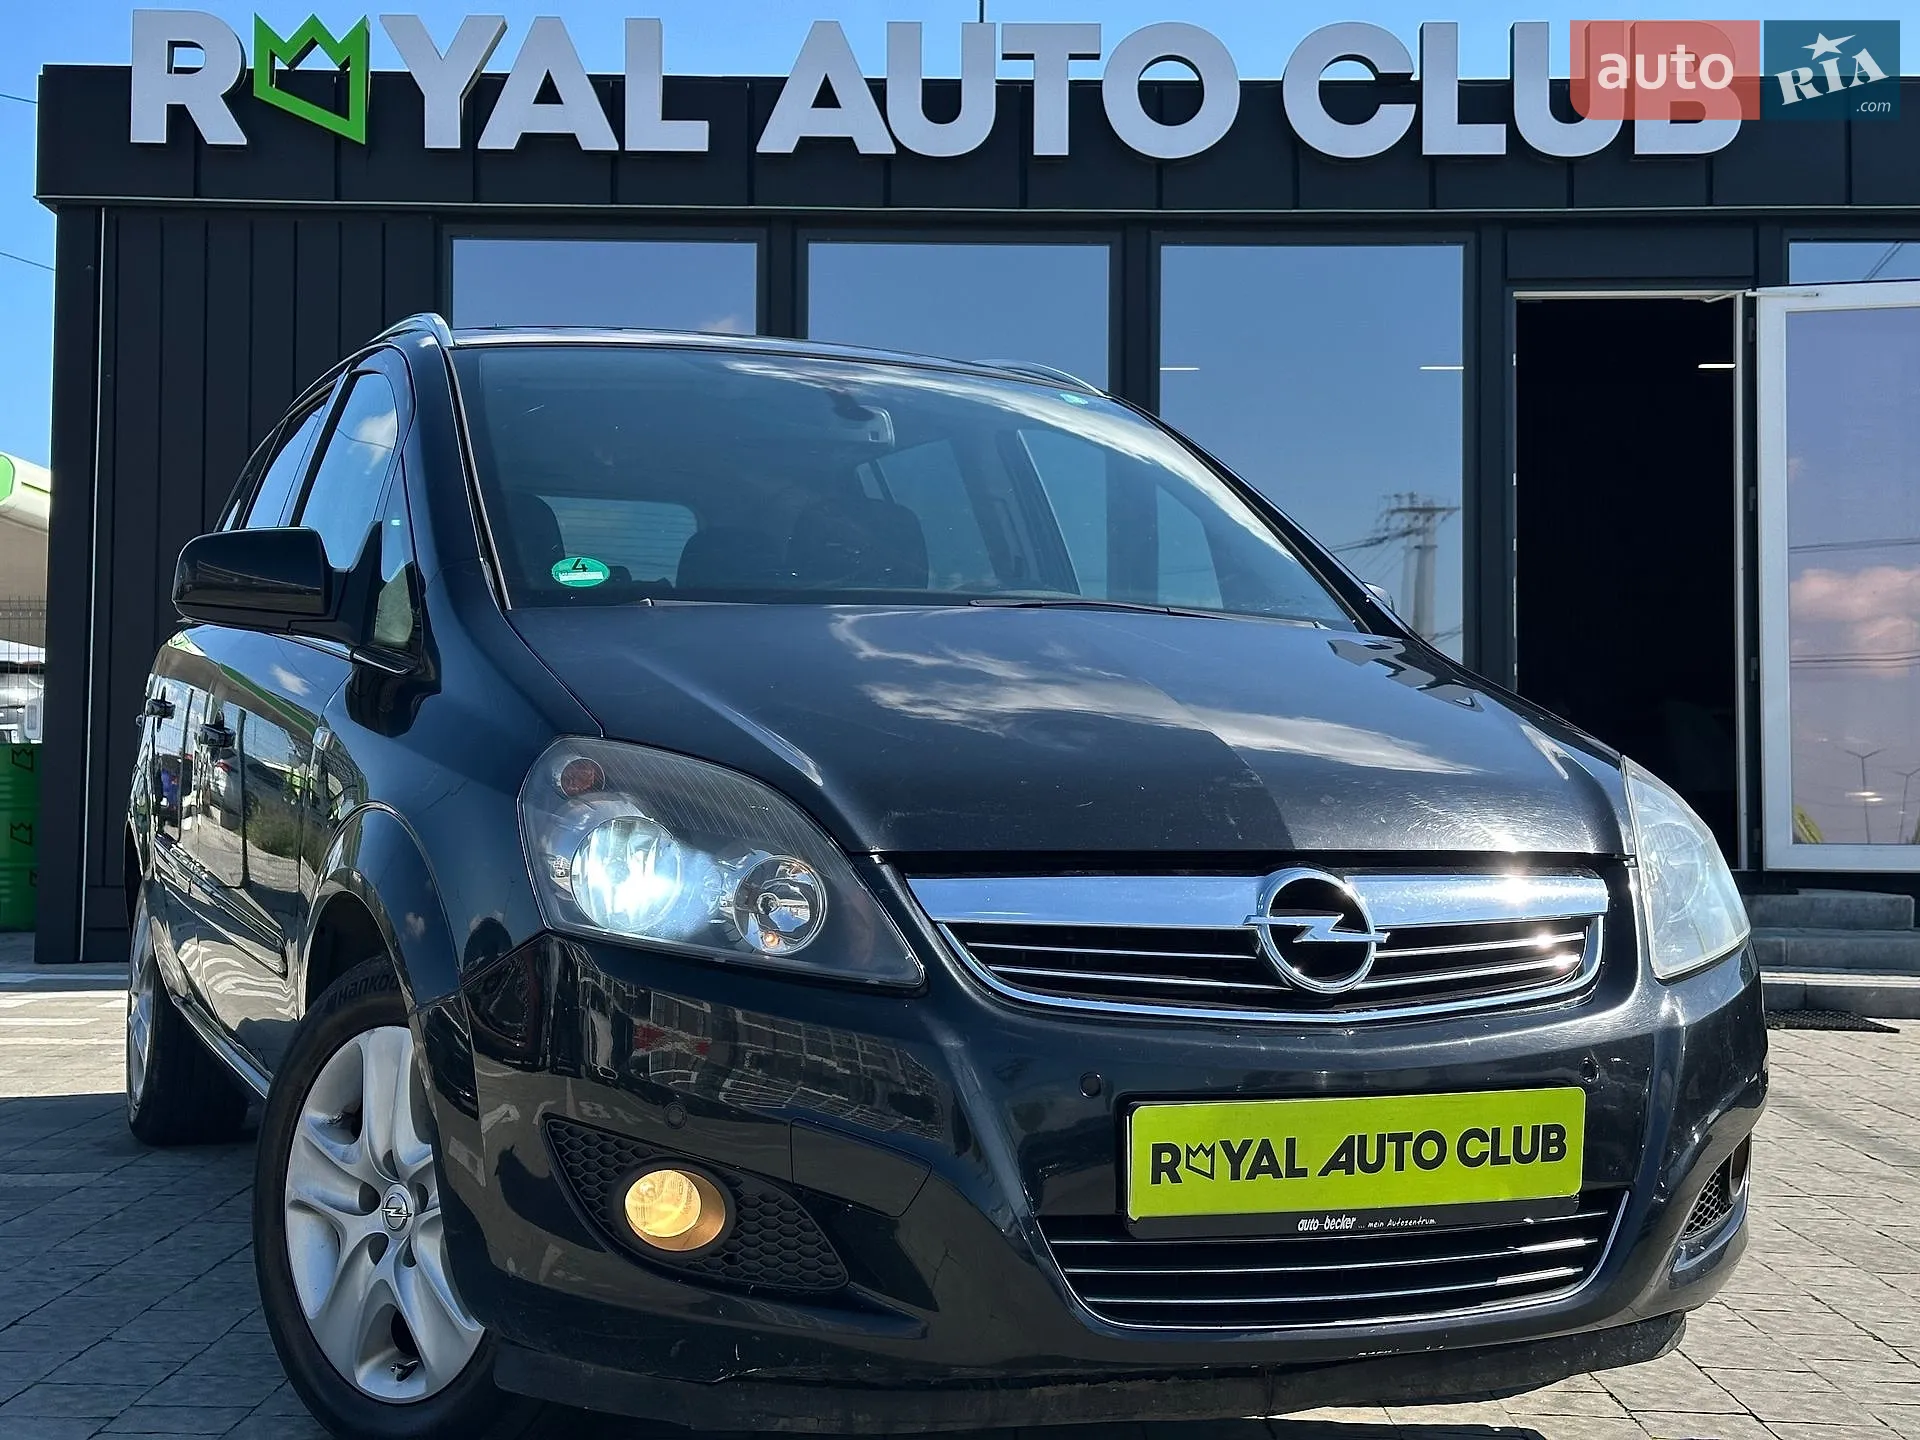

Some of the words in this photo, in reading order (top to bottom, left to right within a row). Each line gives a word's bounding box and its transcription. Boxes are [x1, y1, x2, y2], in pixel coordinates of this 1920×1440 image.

[756, 20, 1241, 159] AUTO
[1282, 20, 1743, 159] CLUB
[571, 557, 589, 573] 4
[1318, 1129, 1448, 1177] AUTO
[1457, 1123, 1567, 1165] CLUB
[1367, 1219, 1385, 1229] mein
